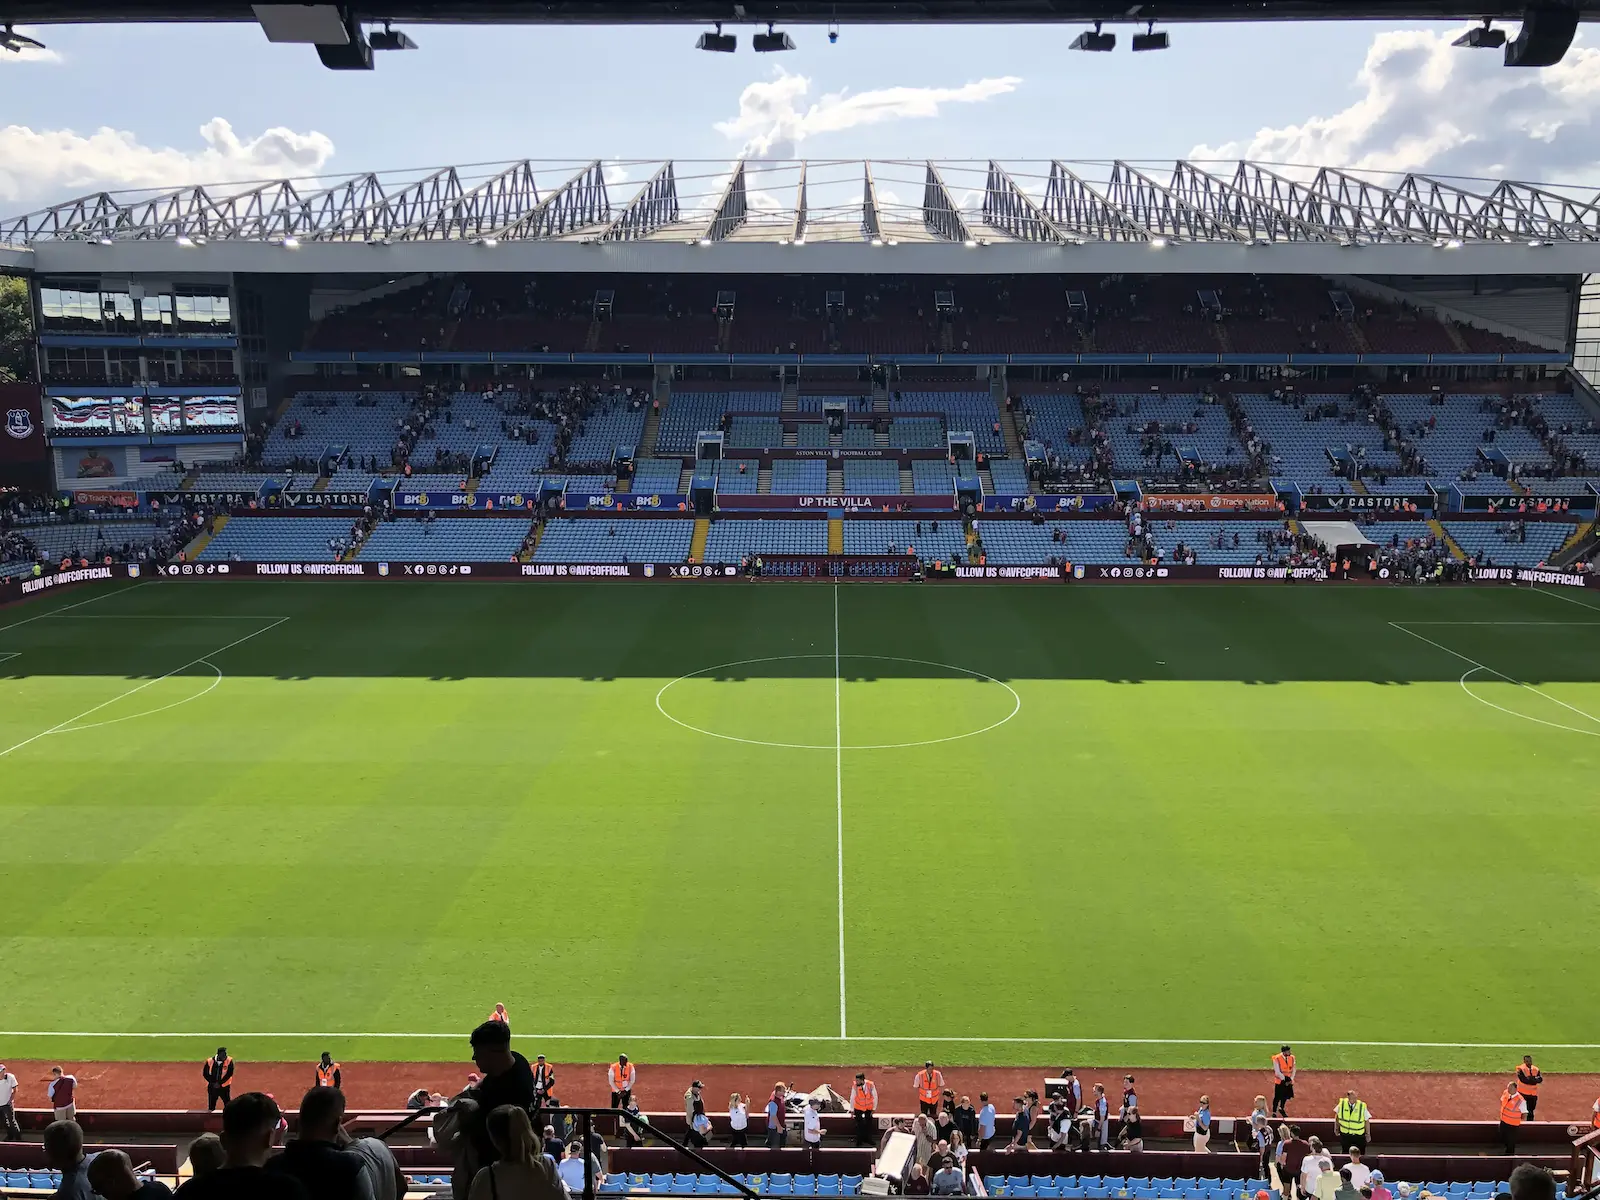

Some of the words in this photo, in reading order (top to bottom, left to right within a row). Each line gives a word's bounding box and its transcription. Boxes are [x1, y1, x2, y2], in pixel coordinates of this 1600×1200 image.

[404, 494, 428, 505] BK8
[452, 494, 476, 505] BK8
[589, 496, 613, 506] BK8
[636, 496, 660, 506] BK8
[800, 498, 814, 506] UP
[816, 498, 838, 506] THE
[840, 498, 872, 506] VILLA
[256, 564, 288, 574] FOLLOW
[291, 564, 302, 574] US
[304, 564, 364, 574] @AVFCOFFICIAL
[522, 565, 554, 576] FOLLOW
[556, 565, 568, 576] US
[568, 566, 630, 576] @AVFCOFFICIAL
[955, 567, 984, 578] OLLOW
[986, 567, 997, 578] US
[998, 567, 1060, 578] @AVFCOFFICIAL
[1219, 568, 1252, 578] FOLLOW
[1254, 568, 1265, 578] US
[1500, 568, 1512, 580] US
[22, 580, 44, 594] FOLLOW
[44, 576, 53, 588] US
[53, 567, 112, 584] @AVFCOFFICIAL
